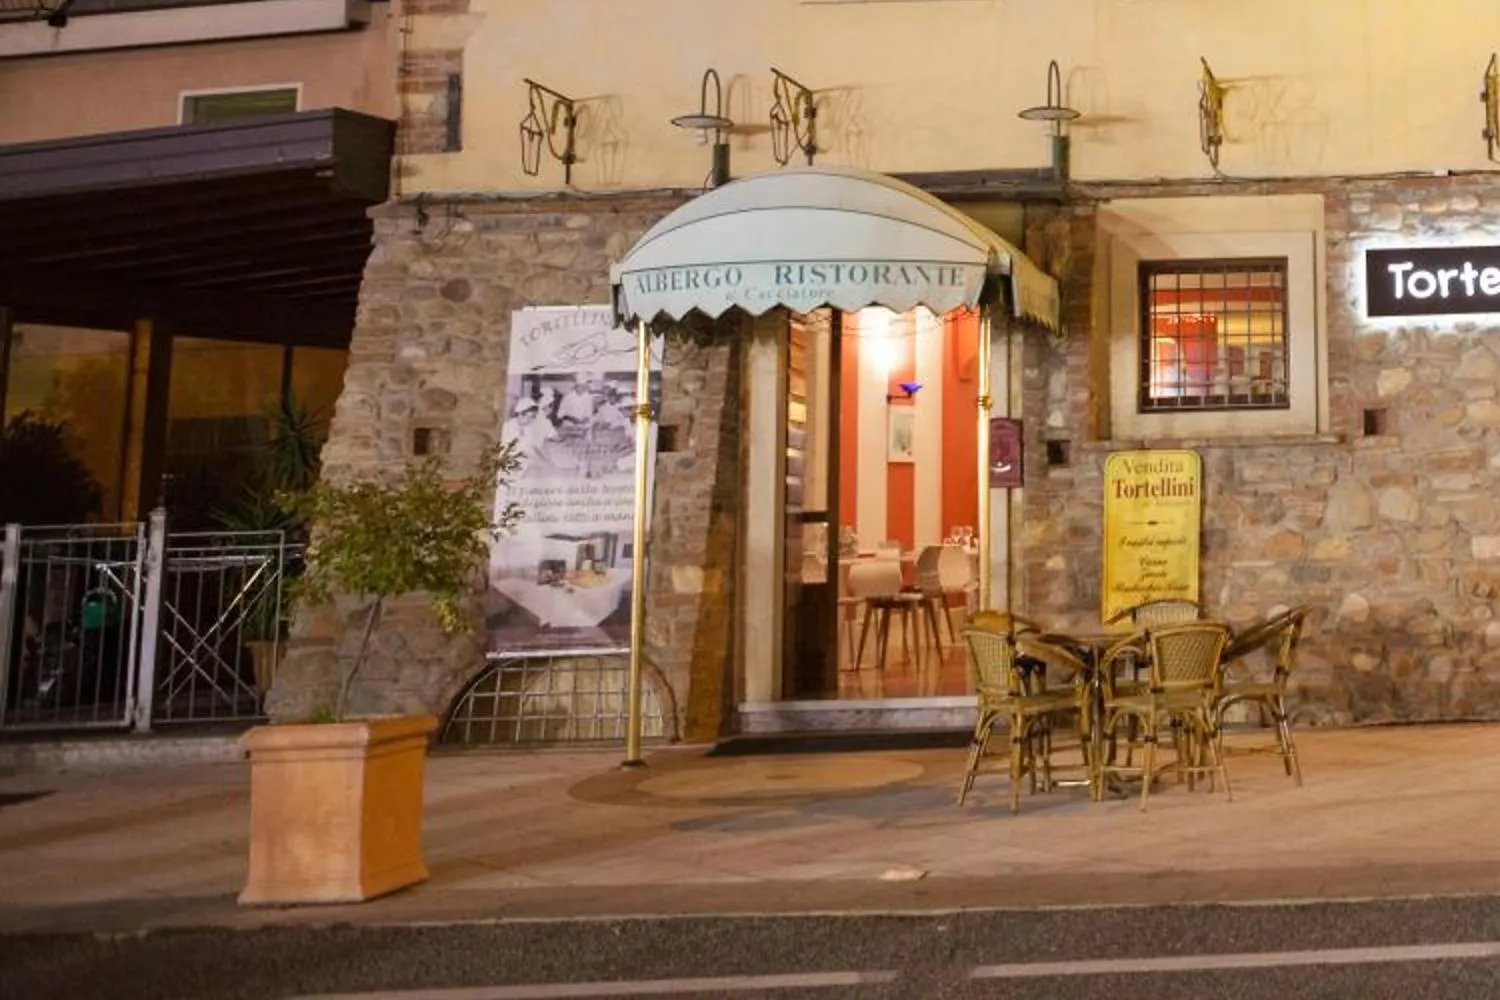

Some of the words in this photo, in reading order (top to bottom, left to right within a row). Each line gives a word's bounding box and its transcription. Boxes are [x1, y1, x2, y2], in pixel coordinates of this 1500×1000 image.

[634, 266, 743, 294] ALBERGO
[774, 263, 965, 287] RISTORANTE
[1122, 459, 1185, 475] Vendita
[1112, 477, 1194, 499] Tortellini
